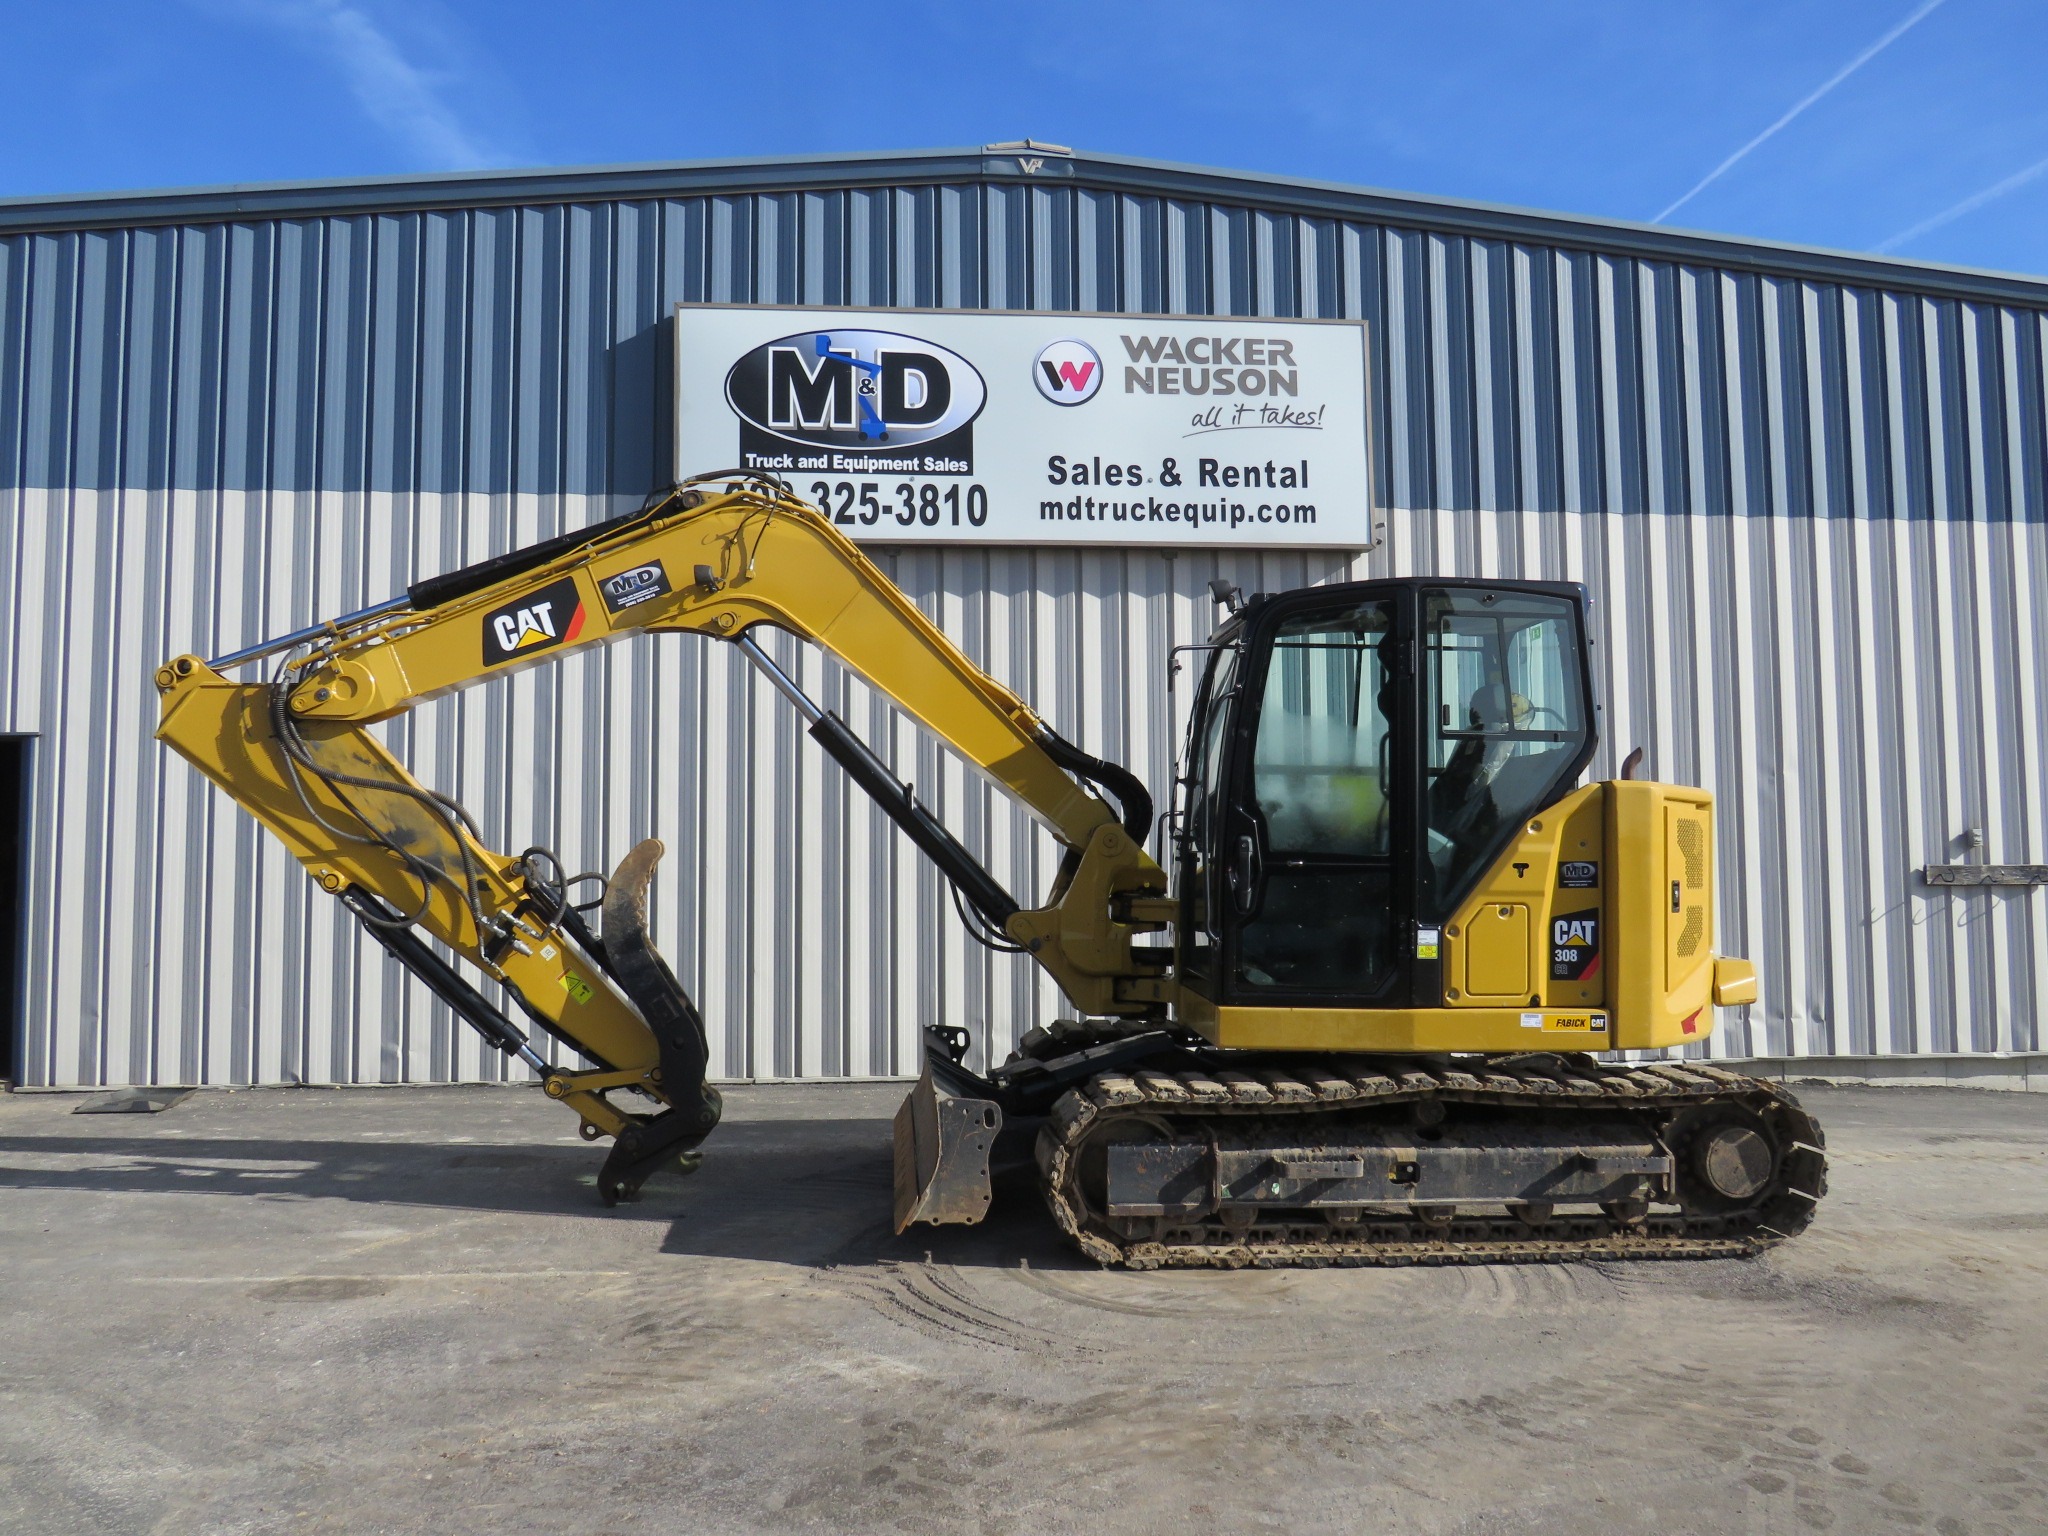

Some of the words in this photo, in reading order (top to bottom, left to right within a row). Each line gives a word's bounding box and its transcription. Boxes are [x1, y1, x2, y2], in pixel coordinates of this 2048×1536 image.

[1120, 335, 1297, 366] WACKER
[1124, 366, 1298, 397] NEUSON
[1191, 405, 1222, 428] all
[1232, 403, 1256, 426] it
[1260, 402, 1326, 426] takes!
[745, 453, 793, 469] Truck
[798, 455, 828, 469] and
[833, 455, 919, 473] Equipment
[924, 457, 968, 472] Sales
[1048, 455, 1143, 486] Sales
[1160, 457, 1182, 487] &
[1199, 458, 1308, 488] Rental
[1040, 496, 1316, 529] mdtruckequip.com
[493, 601, 557, 651] CAT
[1555, 920, 1595, 945] CAT
[1555, 950, 1577, 962] 308
[1556, 1018, 1586, 1027] FABICK
[1591, 1018, 1605, 1028] CAT
